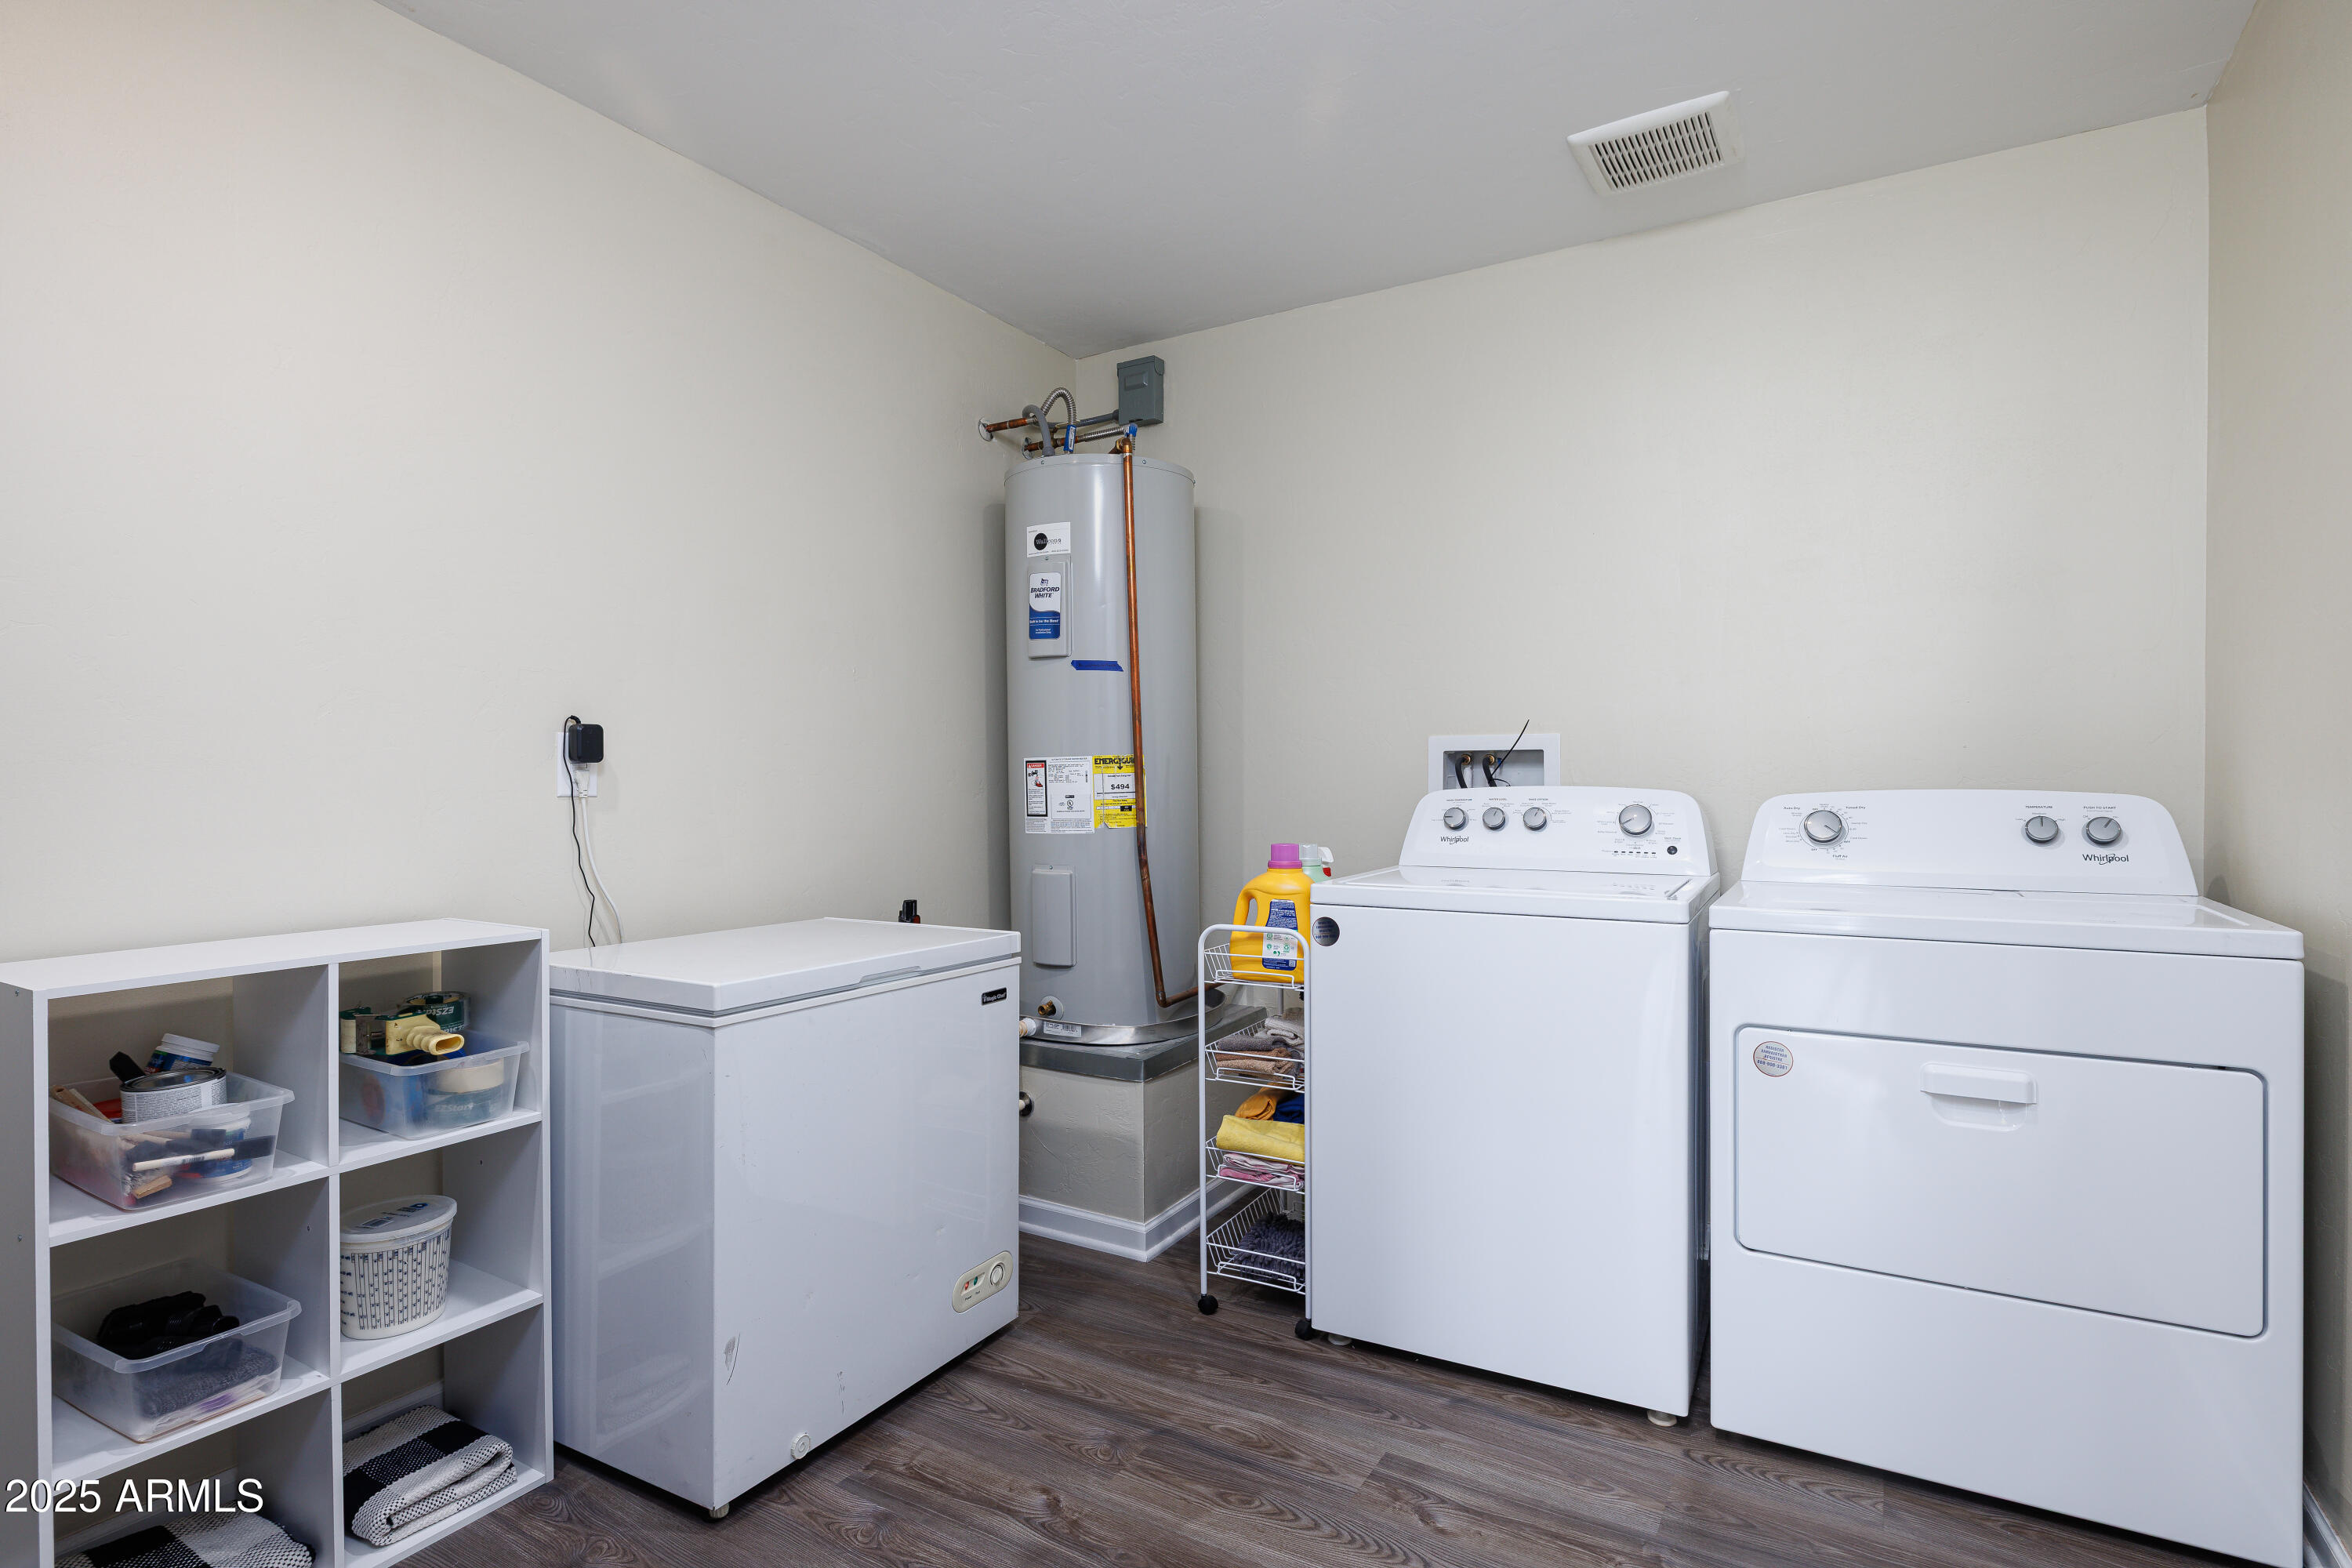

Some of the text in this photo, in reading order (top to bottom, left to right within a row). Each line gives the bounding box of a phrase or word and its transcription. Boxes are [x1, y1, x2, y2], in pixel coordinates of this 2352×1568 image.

[1440, 835, 1469, 845] Whirlpool
[2082, 853, 2129, 865] Whirlpool
[426, 1006, 455, 1016] EZSta
